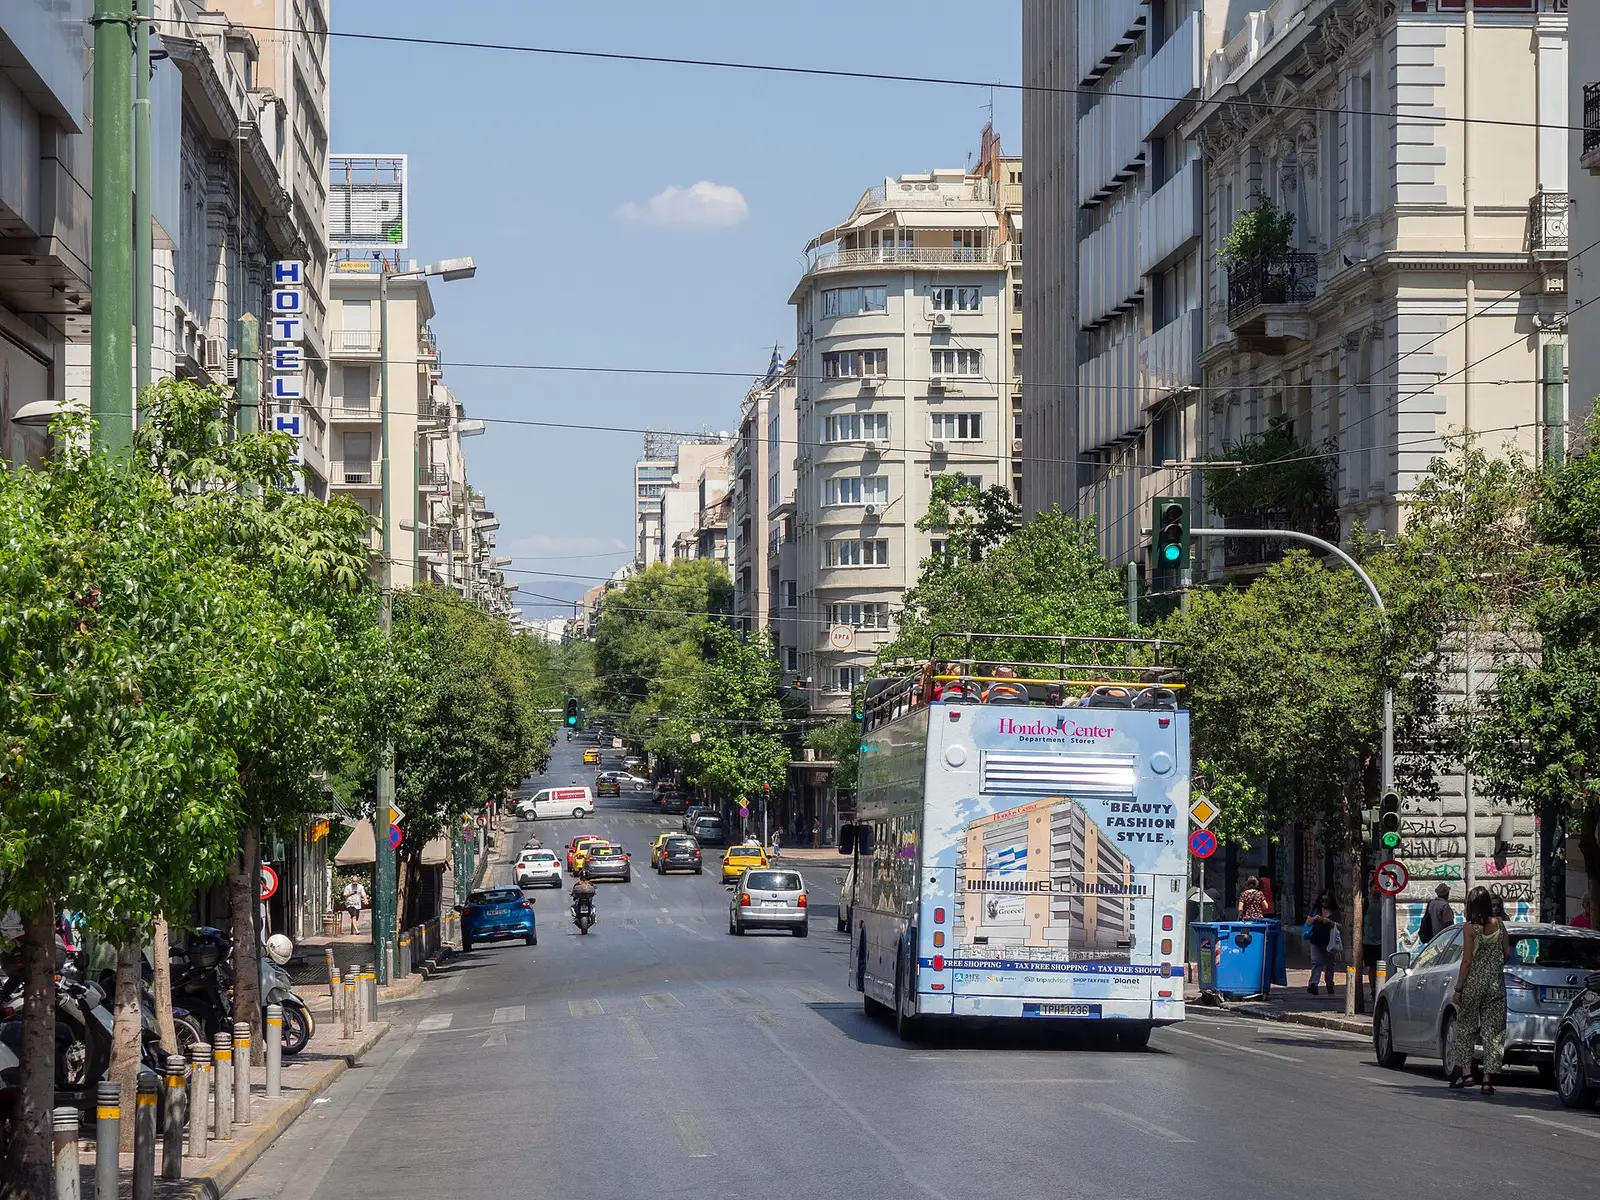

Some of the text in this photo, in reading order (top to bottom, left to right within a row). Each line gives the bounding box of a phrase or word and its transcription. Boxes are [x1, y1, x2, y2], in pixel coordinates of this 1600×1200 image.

[276, 263, 299, 396] HOTEL
[999, 718, 1115, 738] Hondos Center
[1106, 817, 1175, 829] FASHION
[998, 906, 1024, 915] Greece!
[1014, 962, 1029, 970] TAX
[1050, 963, 1088, 971] SHOPPING
[1036, 976, 1069, 984] tripadvisor
